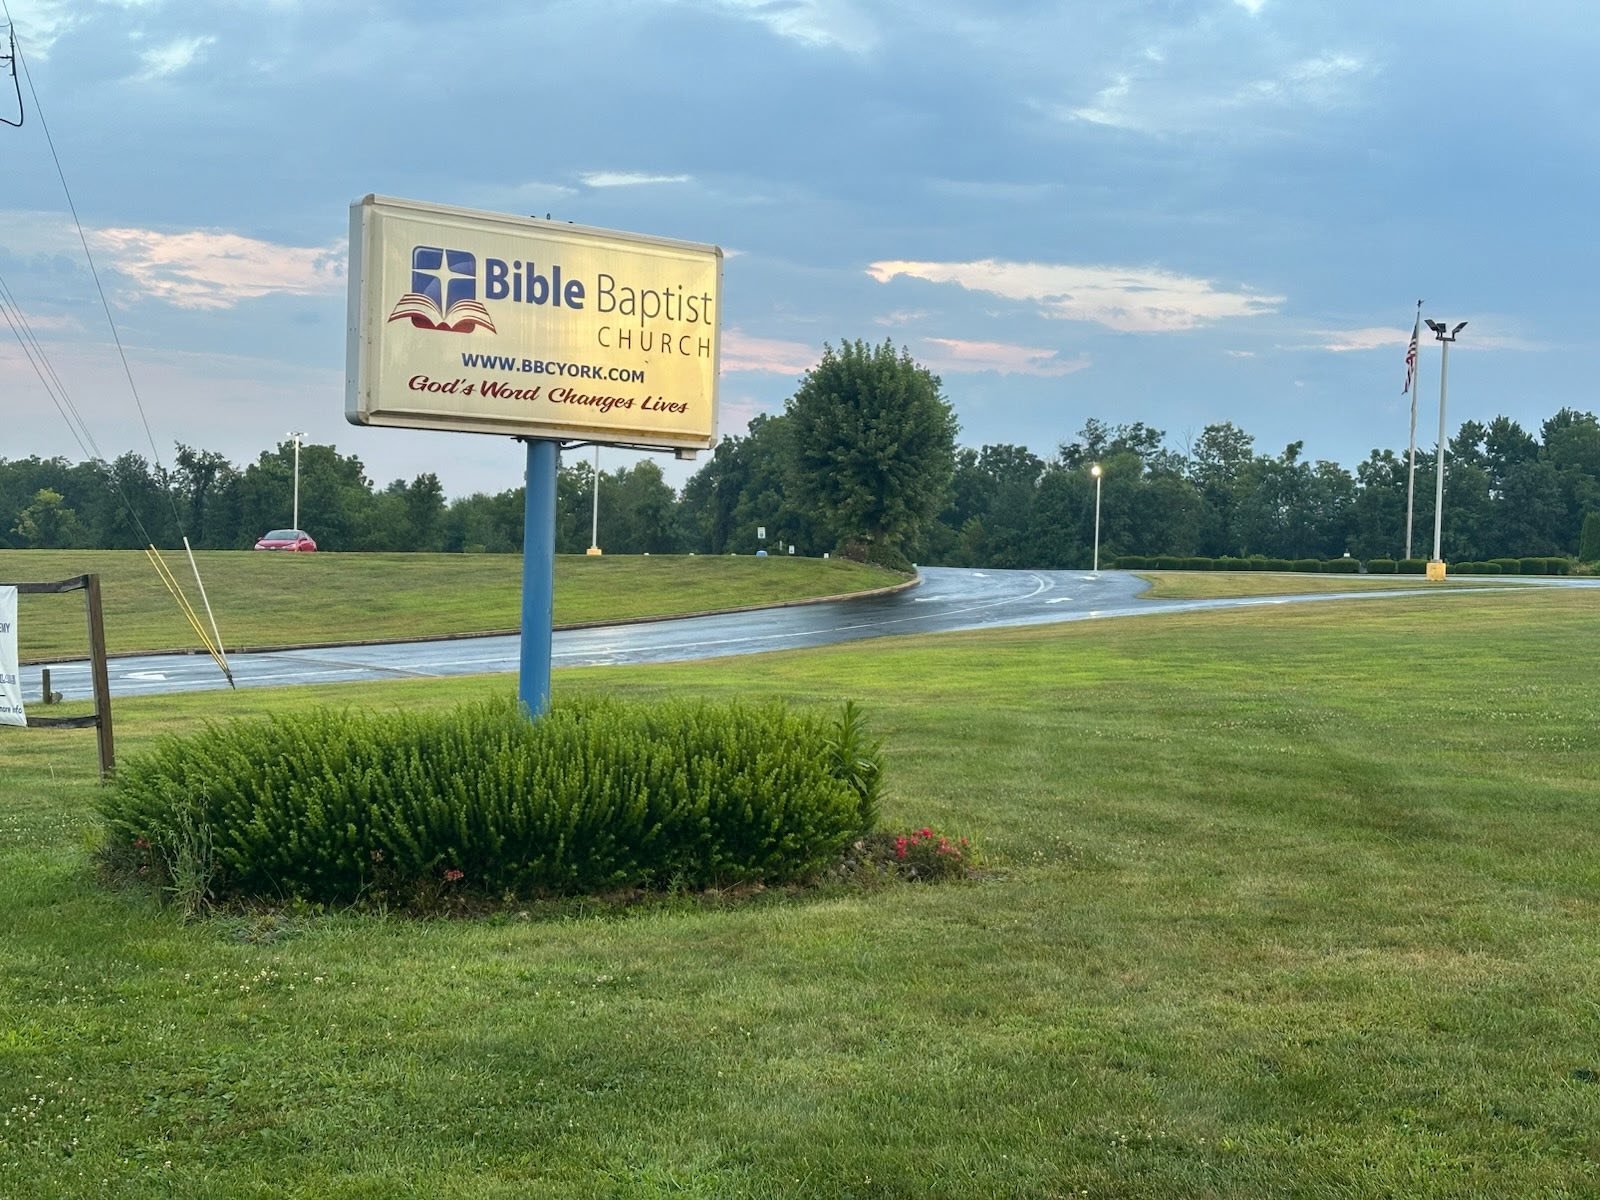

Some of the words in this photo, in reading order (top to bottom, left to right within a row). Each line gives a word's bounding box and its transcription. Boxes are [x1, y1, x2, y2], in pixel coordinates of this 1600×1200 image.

[485, 258, 585, 309] Bible
[597, 273, 713, 327] Baptist
[597, 327, 711, 358] CHURCH
[461, 352, 645, 383] WWW.BBCYORK.COM
[408, 374, 475, 396] God's
[480, 379, 541, 401] Word
[547, 387, 635, 413] Changes
[641, 395, 689, 414] Lives
